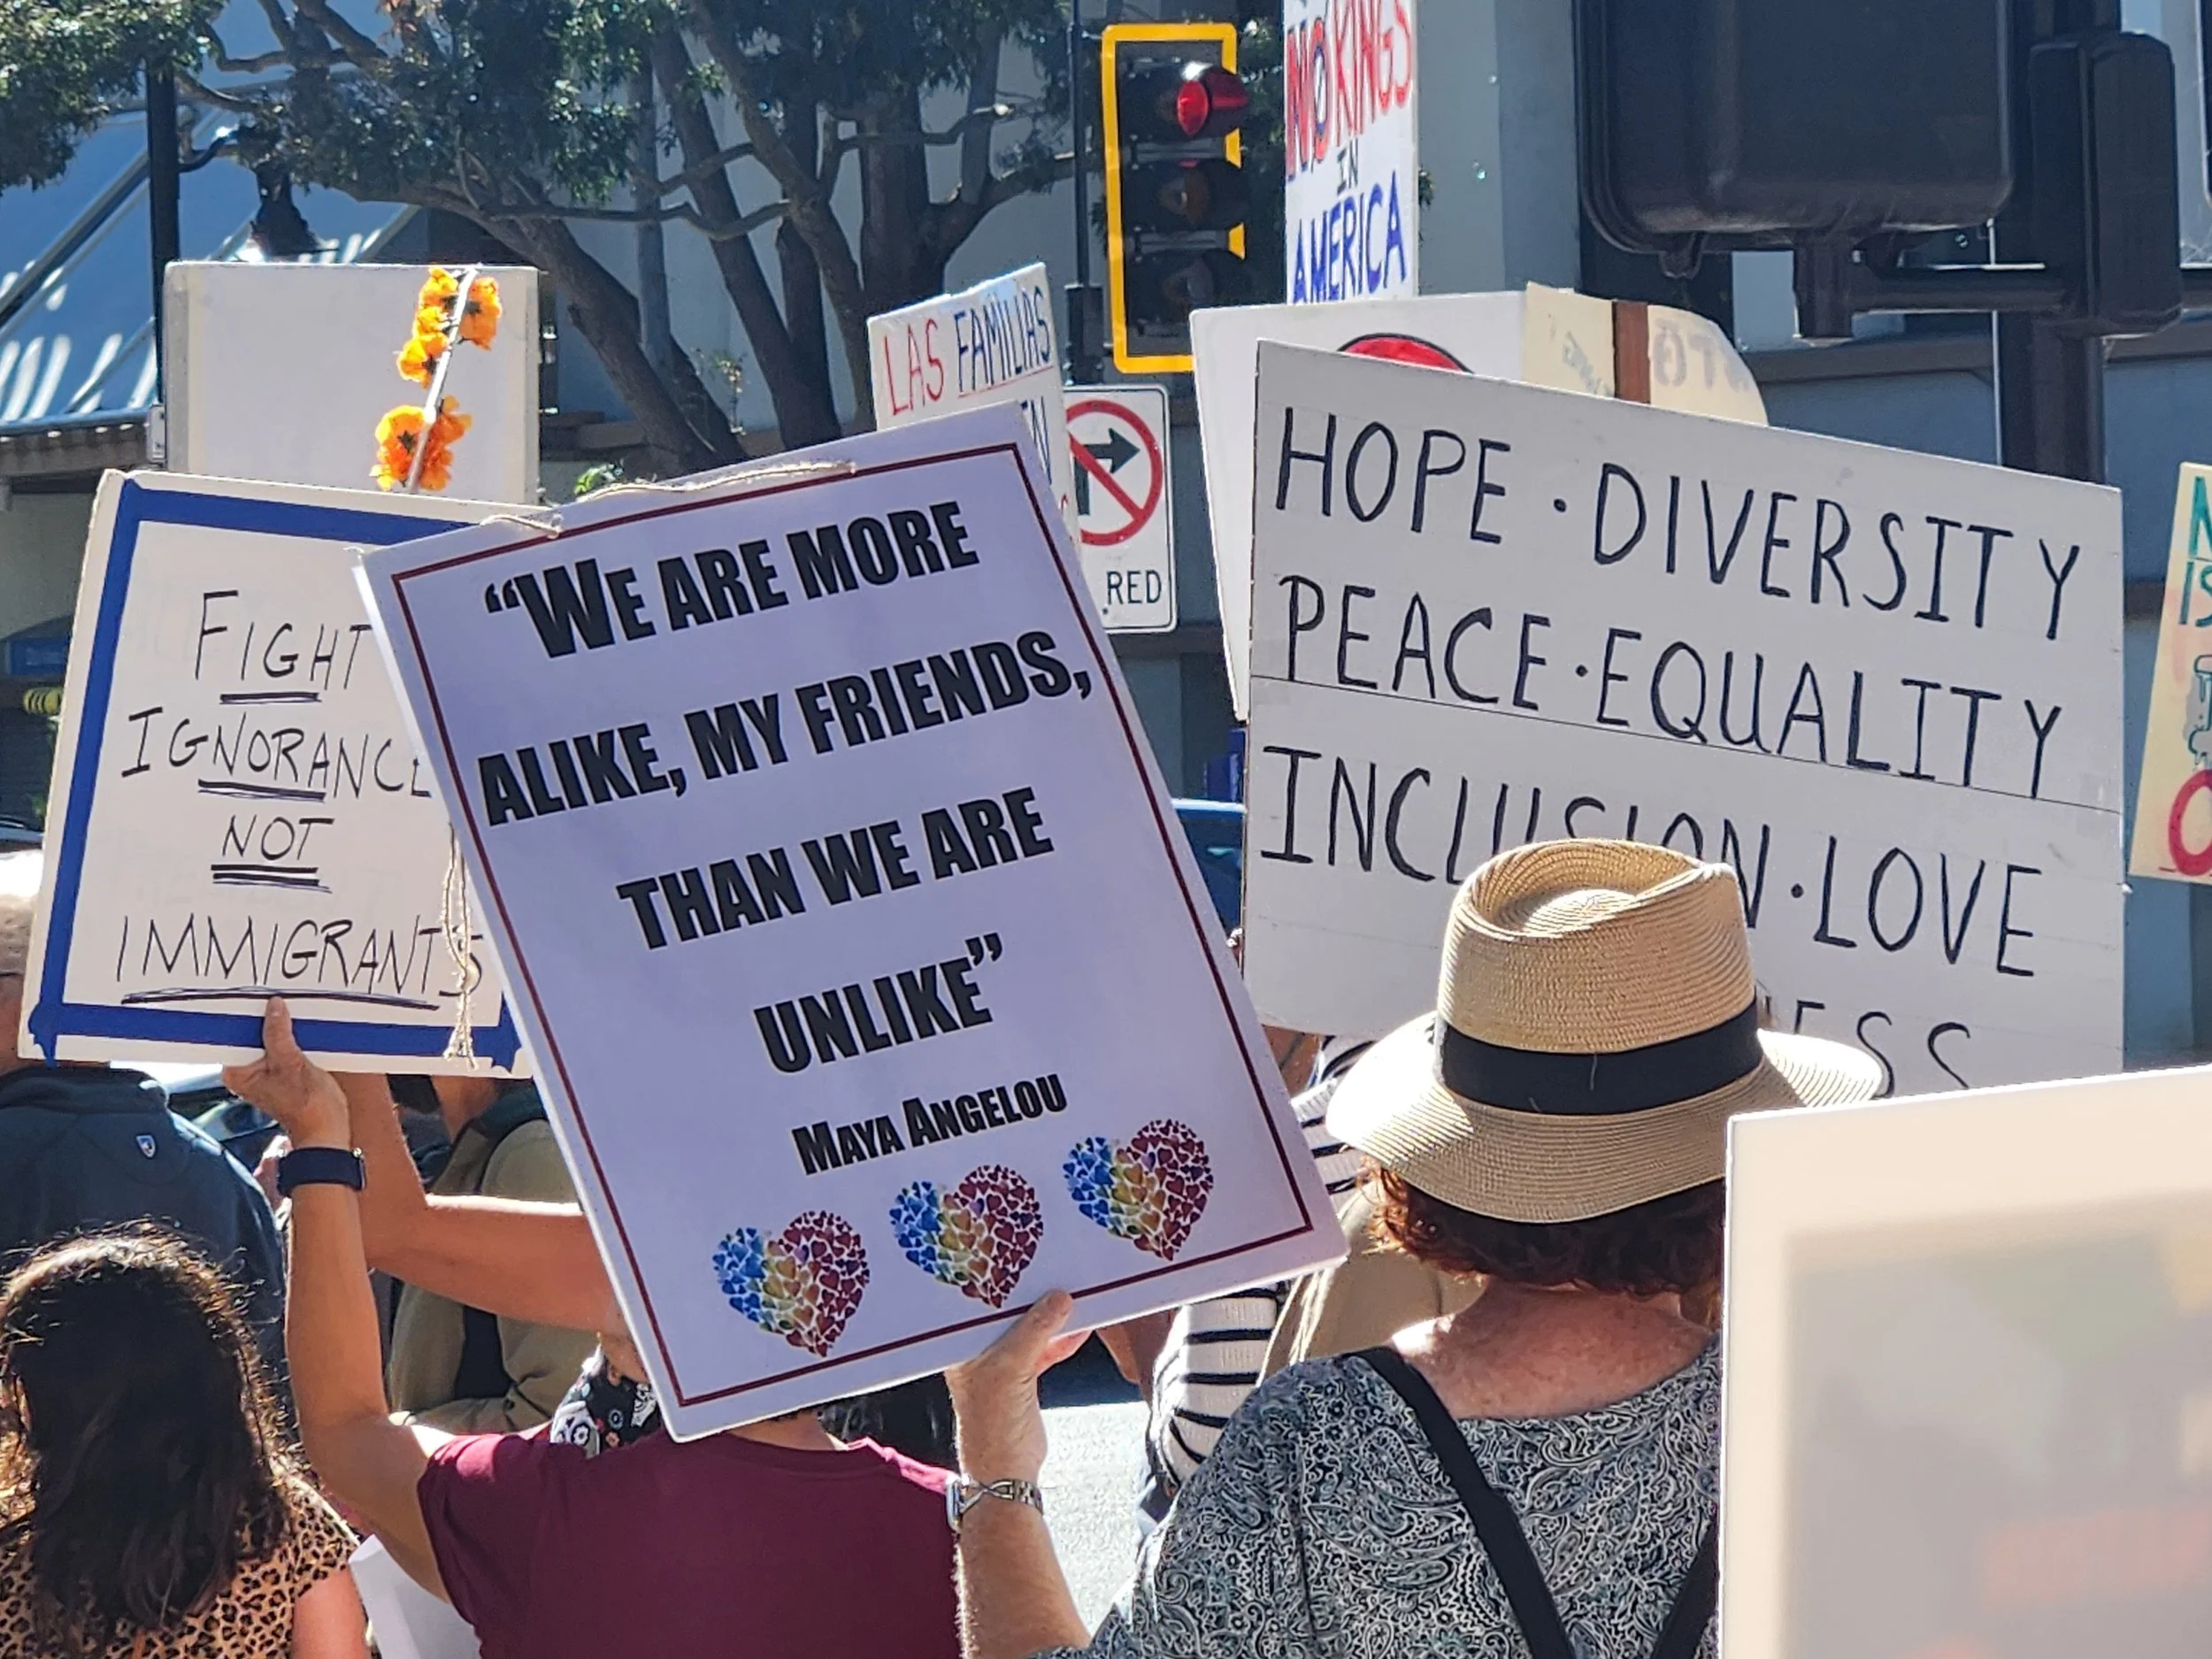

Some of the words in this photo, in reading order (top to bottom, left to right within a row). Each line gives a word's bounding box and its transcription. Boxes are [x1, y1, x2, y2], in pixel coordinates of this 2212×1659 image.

[1337, 137, 1358, 196] IN
[1293, 170, 1407, 305] AMERICA
[884, 318, 945, 416] LAS
[953, 285, 1051, 393] FAMILIAS
[657, 539, 790, 632] ARE
[786, 501, 979, 600] MORE
[1107, 570, 1162, 605] RED
[1276, 406, 1511, 545] HOPE
[1594, 463, 2080, 641] DIVERSITY
[194, 589, 373, 690] FIGHT
[1278, 574, 1551, 711] PEACE
[1596, 626, 2062, 799] EQUALITY
[478, 722, 688, 826] ALIKE,
[684, 693, 790, 780] MY
[795, 631, 1092, 755] FRIENDS,
[221, 814, 334, 861] NOT
[616, 847, 807, 950] THAN
[801, 819, 921, 906] WE
[921, 786, 1056, 880] ARE
[116, 912, 484, 997] IMMIGRANTS
[1813, 835, 2042, 978] LOVE
[754, 932, 1004, 1073] UNLIKE”
[790, 1115, 906, 1176] MAYA
[902, 1073, 1069, 1148] ANGELOU
